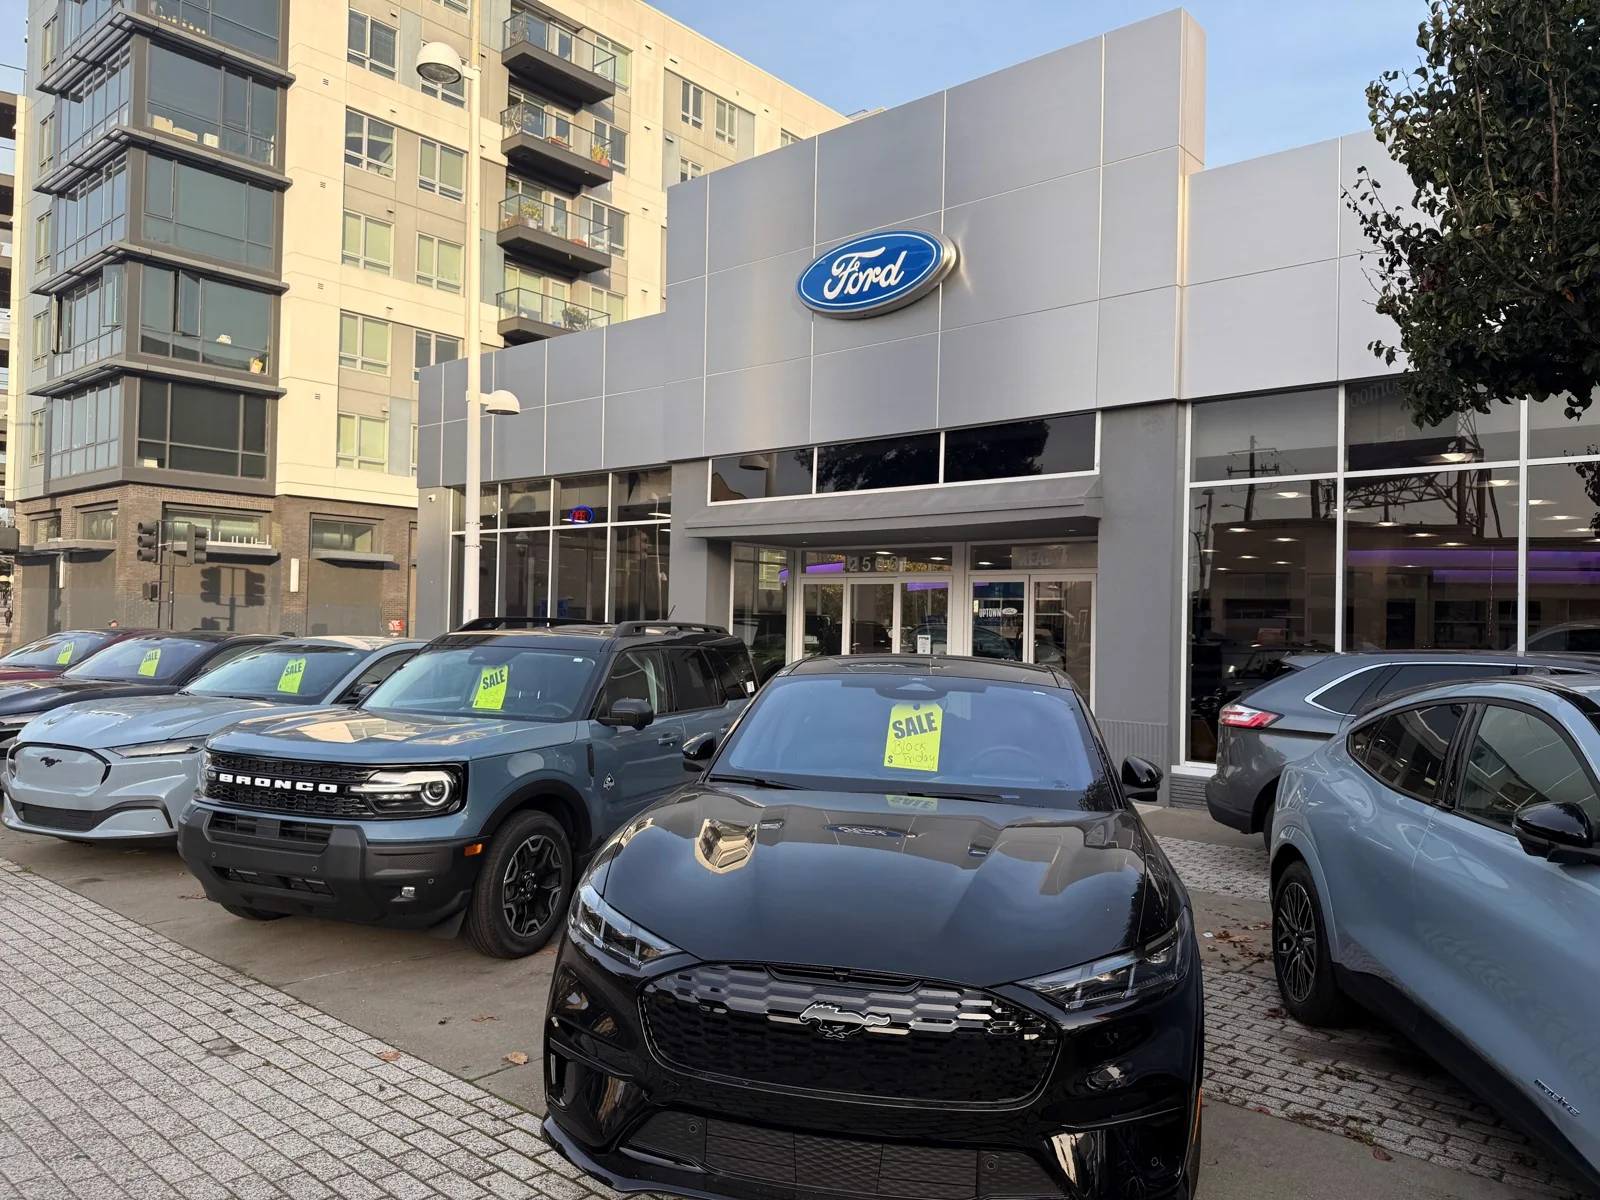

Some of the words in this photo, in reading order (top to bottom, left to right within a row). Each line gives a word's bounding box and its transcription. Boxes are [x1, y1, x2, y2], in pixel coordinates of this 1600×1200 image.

[823, 246, 908, 300] Ford
[572, 509, 589, 521] OPE
[978, 607, 1002, 618] UPTOWN
[143, 651, 158, 663] SALE
[284, 662, 303, 676] SALE
[482, 669, 506, 690] SALE
[892, 711, 938, 739] SALE
[887, 755, 893, 764] $
[219, 773, 338, 793] BRONCO
